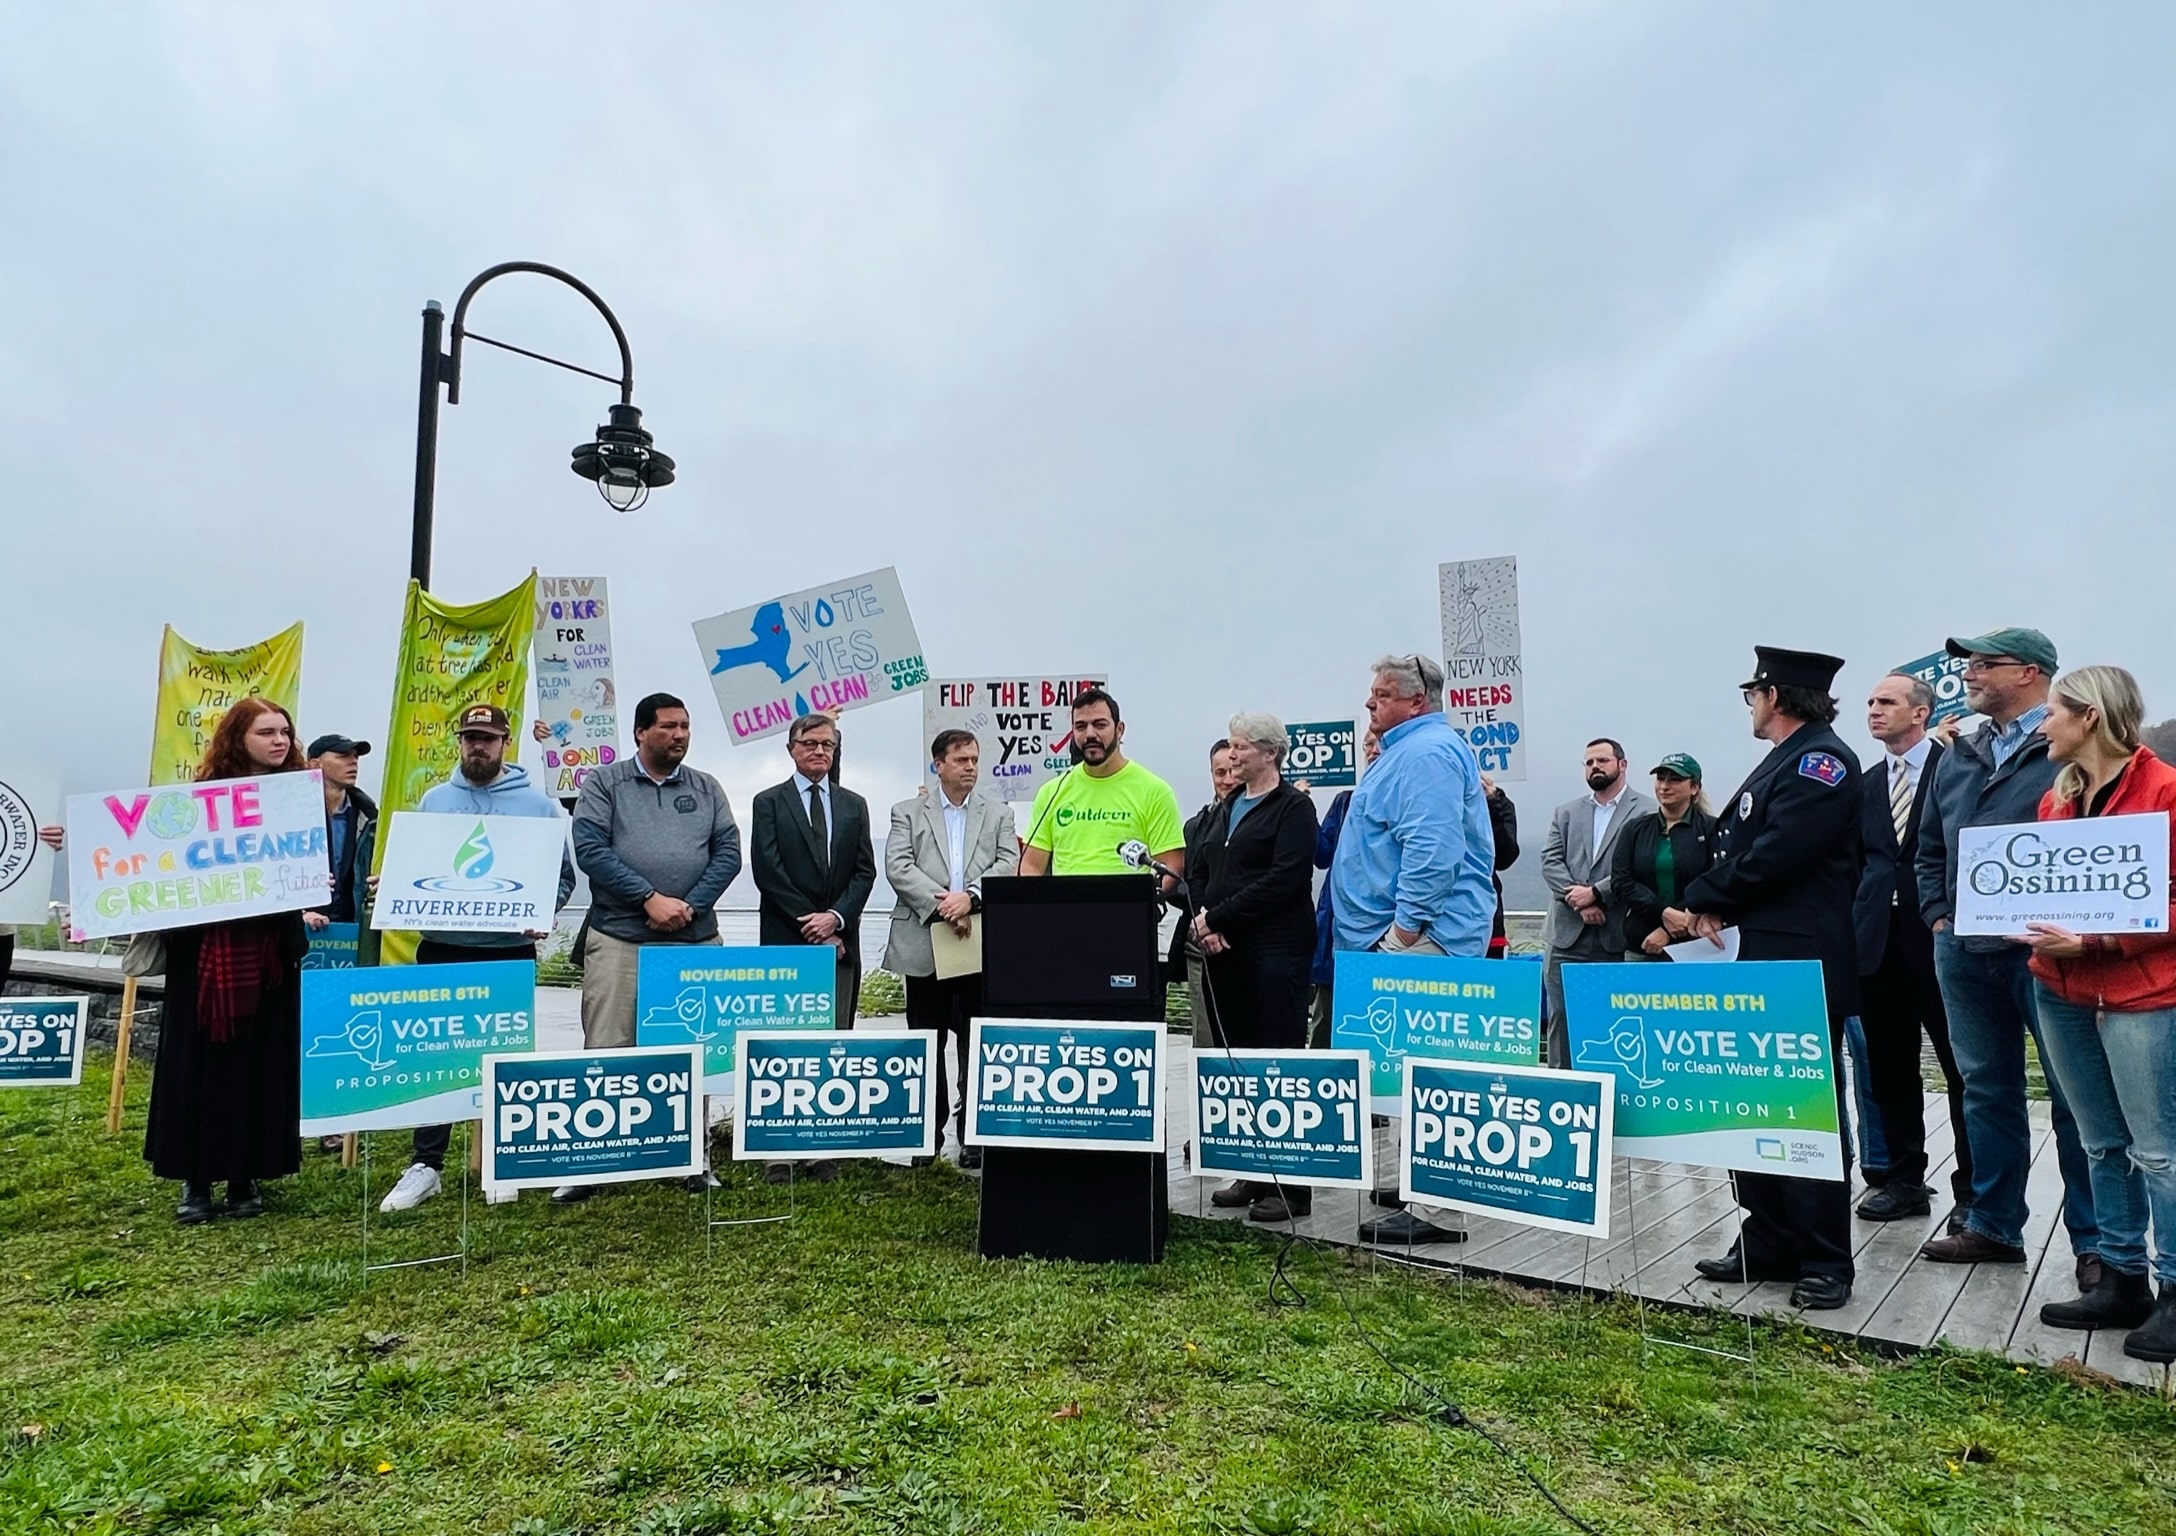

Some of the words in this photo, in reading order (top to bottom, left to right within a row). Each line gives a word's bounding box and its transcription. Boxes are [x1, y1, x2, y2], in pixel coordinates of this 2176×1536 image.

[542, 579, 595, 598] NEW
[789, 584, 884, 633] VOTE
[557, 628, 585, 642] FOR
[574, 643, 607, 656] CLEAN
[804, 629, 879, 681] YES
[573, 657, 610, 670] WATER
[884, 655, 923, 675] GREEN
[1447, 658, 1485, 681] NEW
[1489, 654, 1522, 678] YORK
[537, 677, 571, 688] CLEAN
[891, 669, 929, 691] JOBS
[540, 687, 560, 700] AIR
[940, 682, 975, 707] FLIP
[987, 682, 1030, 708] THE
[1450, 683, 1512, 708] NEEDS
[732, 698, 792, 737] CLEAN
[810, 674, 869, 711] CLEAN
[1460, 709, 1497, 725] THE
[177, 710, 201, 727] one
[583, 714, 615, 726] GREEN
[996, 713, 1052, 730] VOTE
[586, 727, 615, 738] JOBS
[1296, 733, 1325, 745] YES
[1329, 731, 1353, 744] ON
[546, 745, 616, 768] BOND
[998, 735, 1042, 765] YES
[1282, 745, 1333, 768] OP
[1341, 745, 1353, 766] 1
[1472, 747, 1511, 771] CT
[557, 768, 591, 791] AC
[993, 764, 1032, 777] CLEAN
[0, 794, 27, 850] RWATER
[103, 782, 263, 840] VOTE
[93, 847, 148, 881] for
[158, 851, 176, 872] a
[185, 826, 327, 871] CLEANER
[2006, 833, 2144, 868] Green
[1970, 860, 2151, 900] Ossining
[95, 866, 269, 918] GREENER
[390, 900, 536, 917] RIVERKEEPER
[2011, 911, 2114, 922] greenossining.org
[425, 919, 449, 927] clean
[451, 919, 475, 927] water
[477, 919, 518, 928] advocate
[680, 968, 764, 982] NOVEMBER
[769, 968, 798, 981] 8TH
[351, 989, 450, 1006] NOVEMBER
[456, 986, 490, 1000] 8TH
[1372, 978, 1458, 997] NOVEMBER
[1462, 985, 1495, 999] 8TH
[714, 994, 776, 1014] VOTE
[784, 993, 831, 1012] YES
[1611, 993, 1718, 1011] NOVEMBER
[1723, 994, 1766, 1012] 8TH
[43, 1014, 75, 1028] ON
[391, 1015, 464, 1040] VOTE
[474, 1011, 528, 1033] YES
[717, 1017, 731, 1027] for
[735, 1016, 763, 1026] Clean
[766, 1016, 795, 1026] Water
[798, 1016, 805, 1024] &
[807, 1015, 830, 1024] Jobs
[1404, 1008, 1469, 1035] VOTE
[1478, 1014, 1533, 1040] YES
[0, 1029, 45, 1055] OP
[57, 1029, 71, 1054] 1
[396, 1043, 413, 1054] for
[416, 1040, 449, 1052] Clean
[453, 1038, 487, 1049] Water
[490, 1037, 499, 1046] &
[502, 1035, 528, 1046] Jobs
[1407, 1033, 1421, 1044] for
[1424, 1035, 1454, 1048] Clean
[1458, 1039, 1490, 1051] Water
[1493, 1042, 1501, 1051] &
[1505, 1043, 1532, 1055] Jobs
[1653, 1029, 1738, 1058] VOTE
[1748, 1032, 1822, 1061] YES
[749, 1057, 820, 1077] VOTE
[828, 1056, 878, 1077] YES
[885, 1056, 923, 1076] ON
[982, 1043, 1050, 1064] VOTE
[1057, 1045, 1107, 1066] YES
[1113, 1047, 1152, 1068] ON
[336, 1068, 482, 1090] PROPOSITION
[1662, 1059, 1679, 1072] for
[1684, 1060, 1722, 1074] Clean
[1727, 1062, 1769, 1077] Water
[1774, 1065, 1784, 1078] &
[1788, 1064, 1824, 1080] Jobs
[497, 1078, 576, 1101] VOTE
[584, 1075, 639, 1097] YES
[647, 1072, 688, 1094] ON
[750, 1078, 889, 1116] PROP
[903, 1078, 920, 1114] 1
[982, 1065, 1118, 1104] PROP
[1132, 1070, 1149, 1106] 1
[1200, 1075, 1258, 1096] VOTE
[1264, 1077, 1311, 1098] YES
[1317, 1078, 1357, 1100] ON
[1414, 1086, 1480, 1116] VOTE
[1488, 1094, 1541, 1122] YES
[1549, 1101, 1596, 1129] ON
[1621, 1093, 1769, 1118] ROPOSITION
[1787, 1106, 1797, 1119] 1
[500, 1098, 652, 1143] PROP
[666, 1094, 686, 1131] 1
[1202, 1097, 1323, 1139] PROP
[1336, 1102, 1355, 1141] 1
[496, 1146, 516, 1154] FOR
[518, 1144, 549, 1153] CLEAN
[551, 1143, 571, 1152] AIR,
[572, 1141, 604, 1150] CLEAN
[606, 1138, 642, 1148] WATER,
[666, 1134, 689, 1143] JOBS
[1415, 1112, 1552, 1169] PROP
[1569, 1131, 1592, 1178] 1
[1412, 1156, 1428, 1166] FOR
[1429, 1159, 1456, 1171] CLEAN
[1457, 1163, 1473, 1175] AIR,
[1475, 1165, 1504, 1179] CLEAN
[1505, 1170, 1539, 1185] WATER,
[1541, 1176, 1563, 1188] AND
[1565, 1179, 1593, 1193] JOBS
